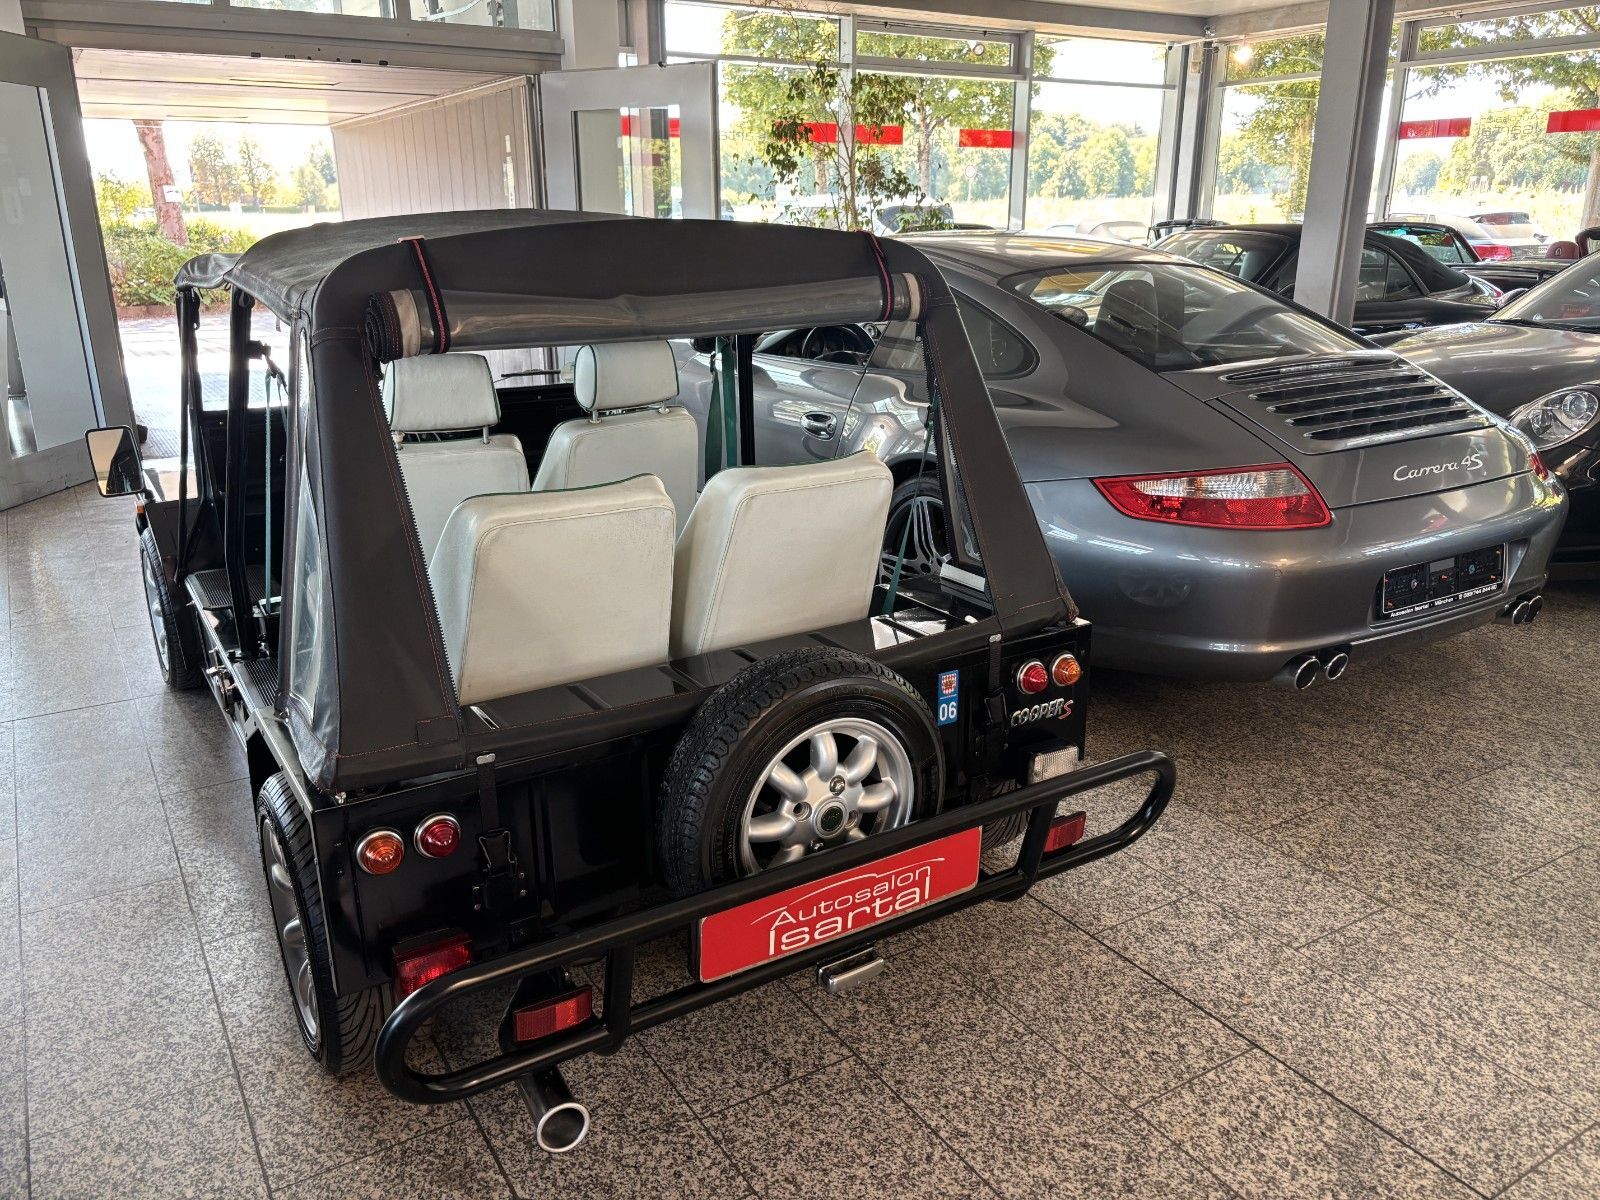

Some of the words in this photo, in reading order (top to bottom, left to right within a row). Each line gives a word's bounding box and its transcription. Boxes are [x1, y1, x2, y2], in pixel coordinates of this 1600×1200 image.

[1393, 461, 1460, 481] Carrera
[1461, 453, 1483, 471] 4S
[939, 701, 957, 721] 06
[769, 876, 931, 955] Isartal
[771, 865, 931, 930] Autosalon
